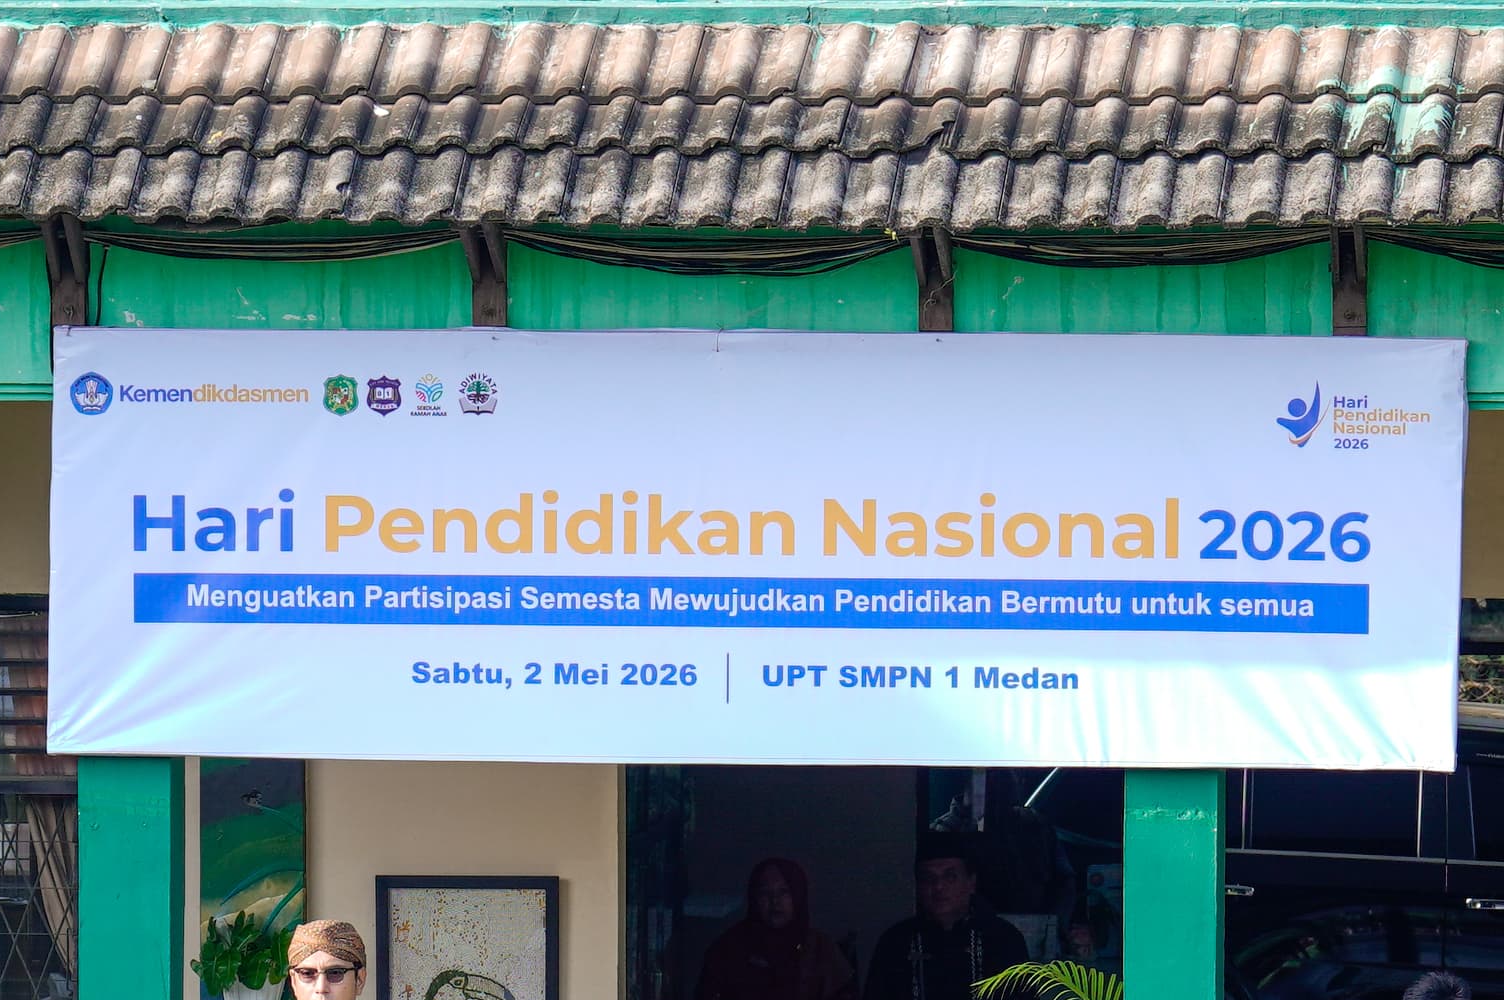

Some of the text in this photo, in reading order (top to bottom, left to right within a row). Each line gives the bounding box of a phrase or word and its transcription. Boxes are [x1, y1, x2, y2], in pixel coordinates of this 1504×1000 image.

[119, 384, 309, 403] Kemendikdasmen
[459, 373, 498, 394] ADIWIYATA
[1333, 395, 1368, 409] Hari
[1333, 409, 1430, 423] Pendidikan
[1333, 422, 1406, 435] Nasional
[1334, 438, 1369, 450] 2026
[133, 488, 1372, 563] Hari Pendidikan Nasional 2026
[187, 584, 1314, 618] Menguatkan Partisipasi Semesta Mewujudkan Pendidikan Bermutu untuk semua
[411, 661, 698, 690] Sabtu, 2 Mei 2026
[762, 664, 1079, 690] UPT SMPN 1 Medan
